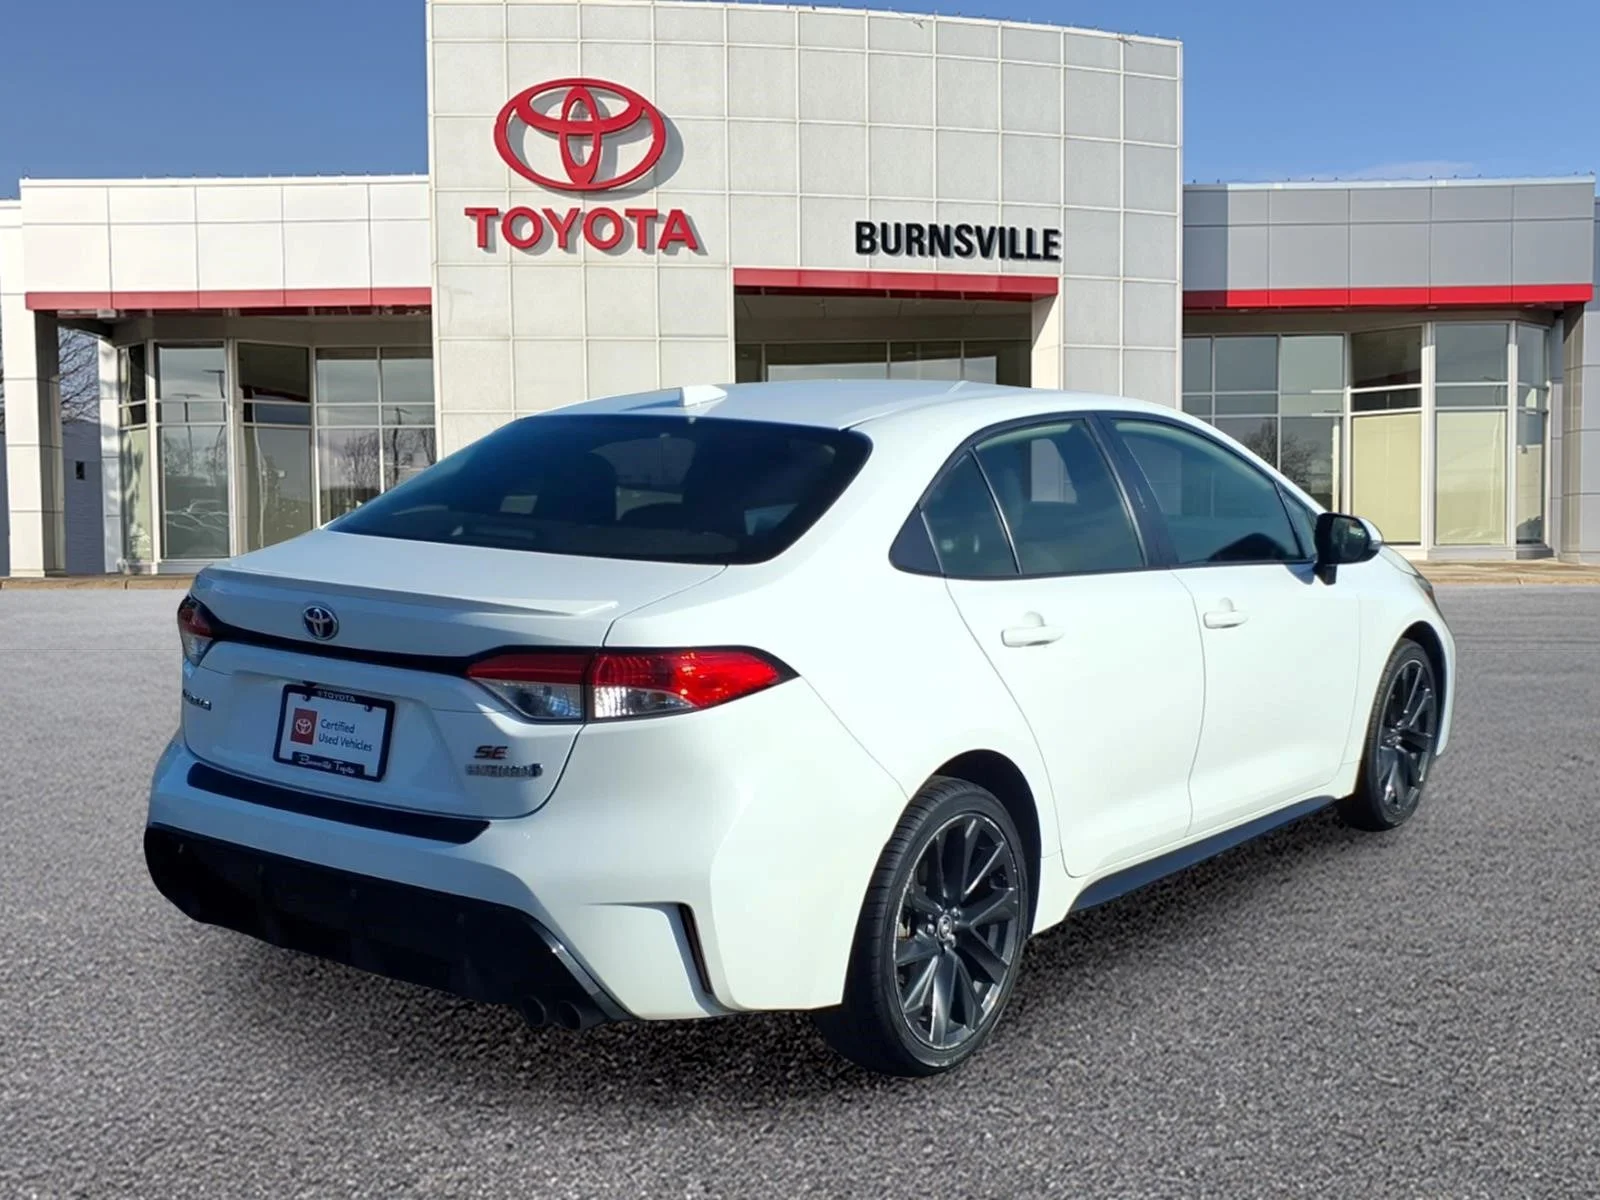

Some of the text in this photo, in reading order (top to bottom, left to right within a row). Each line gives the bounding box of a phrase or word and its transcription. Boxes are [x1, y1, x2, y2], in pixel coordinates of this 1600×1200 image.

[464, 206, 699, 250] TOYOTA
[855, 221, 1060, 261] BURNSVILLE
[323, 691, 356, 702] TOYOTA
[320, 718, 356, 734] Certified
[318, 732, 373, 752] Used Vehicles
[474, 745, 508, 760] SE
